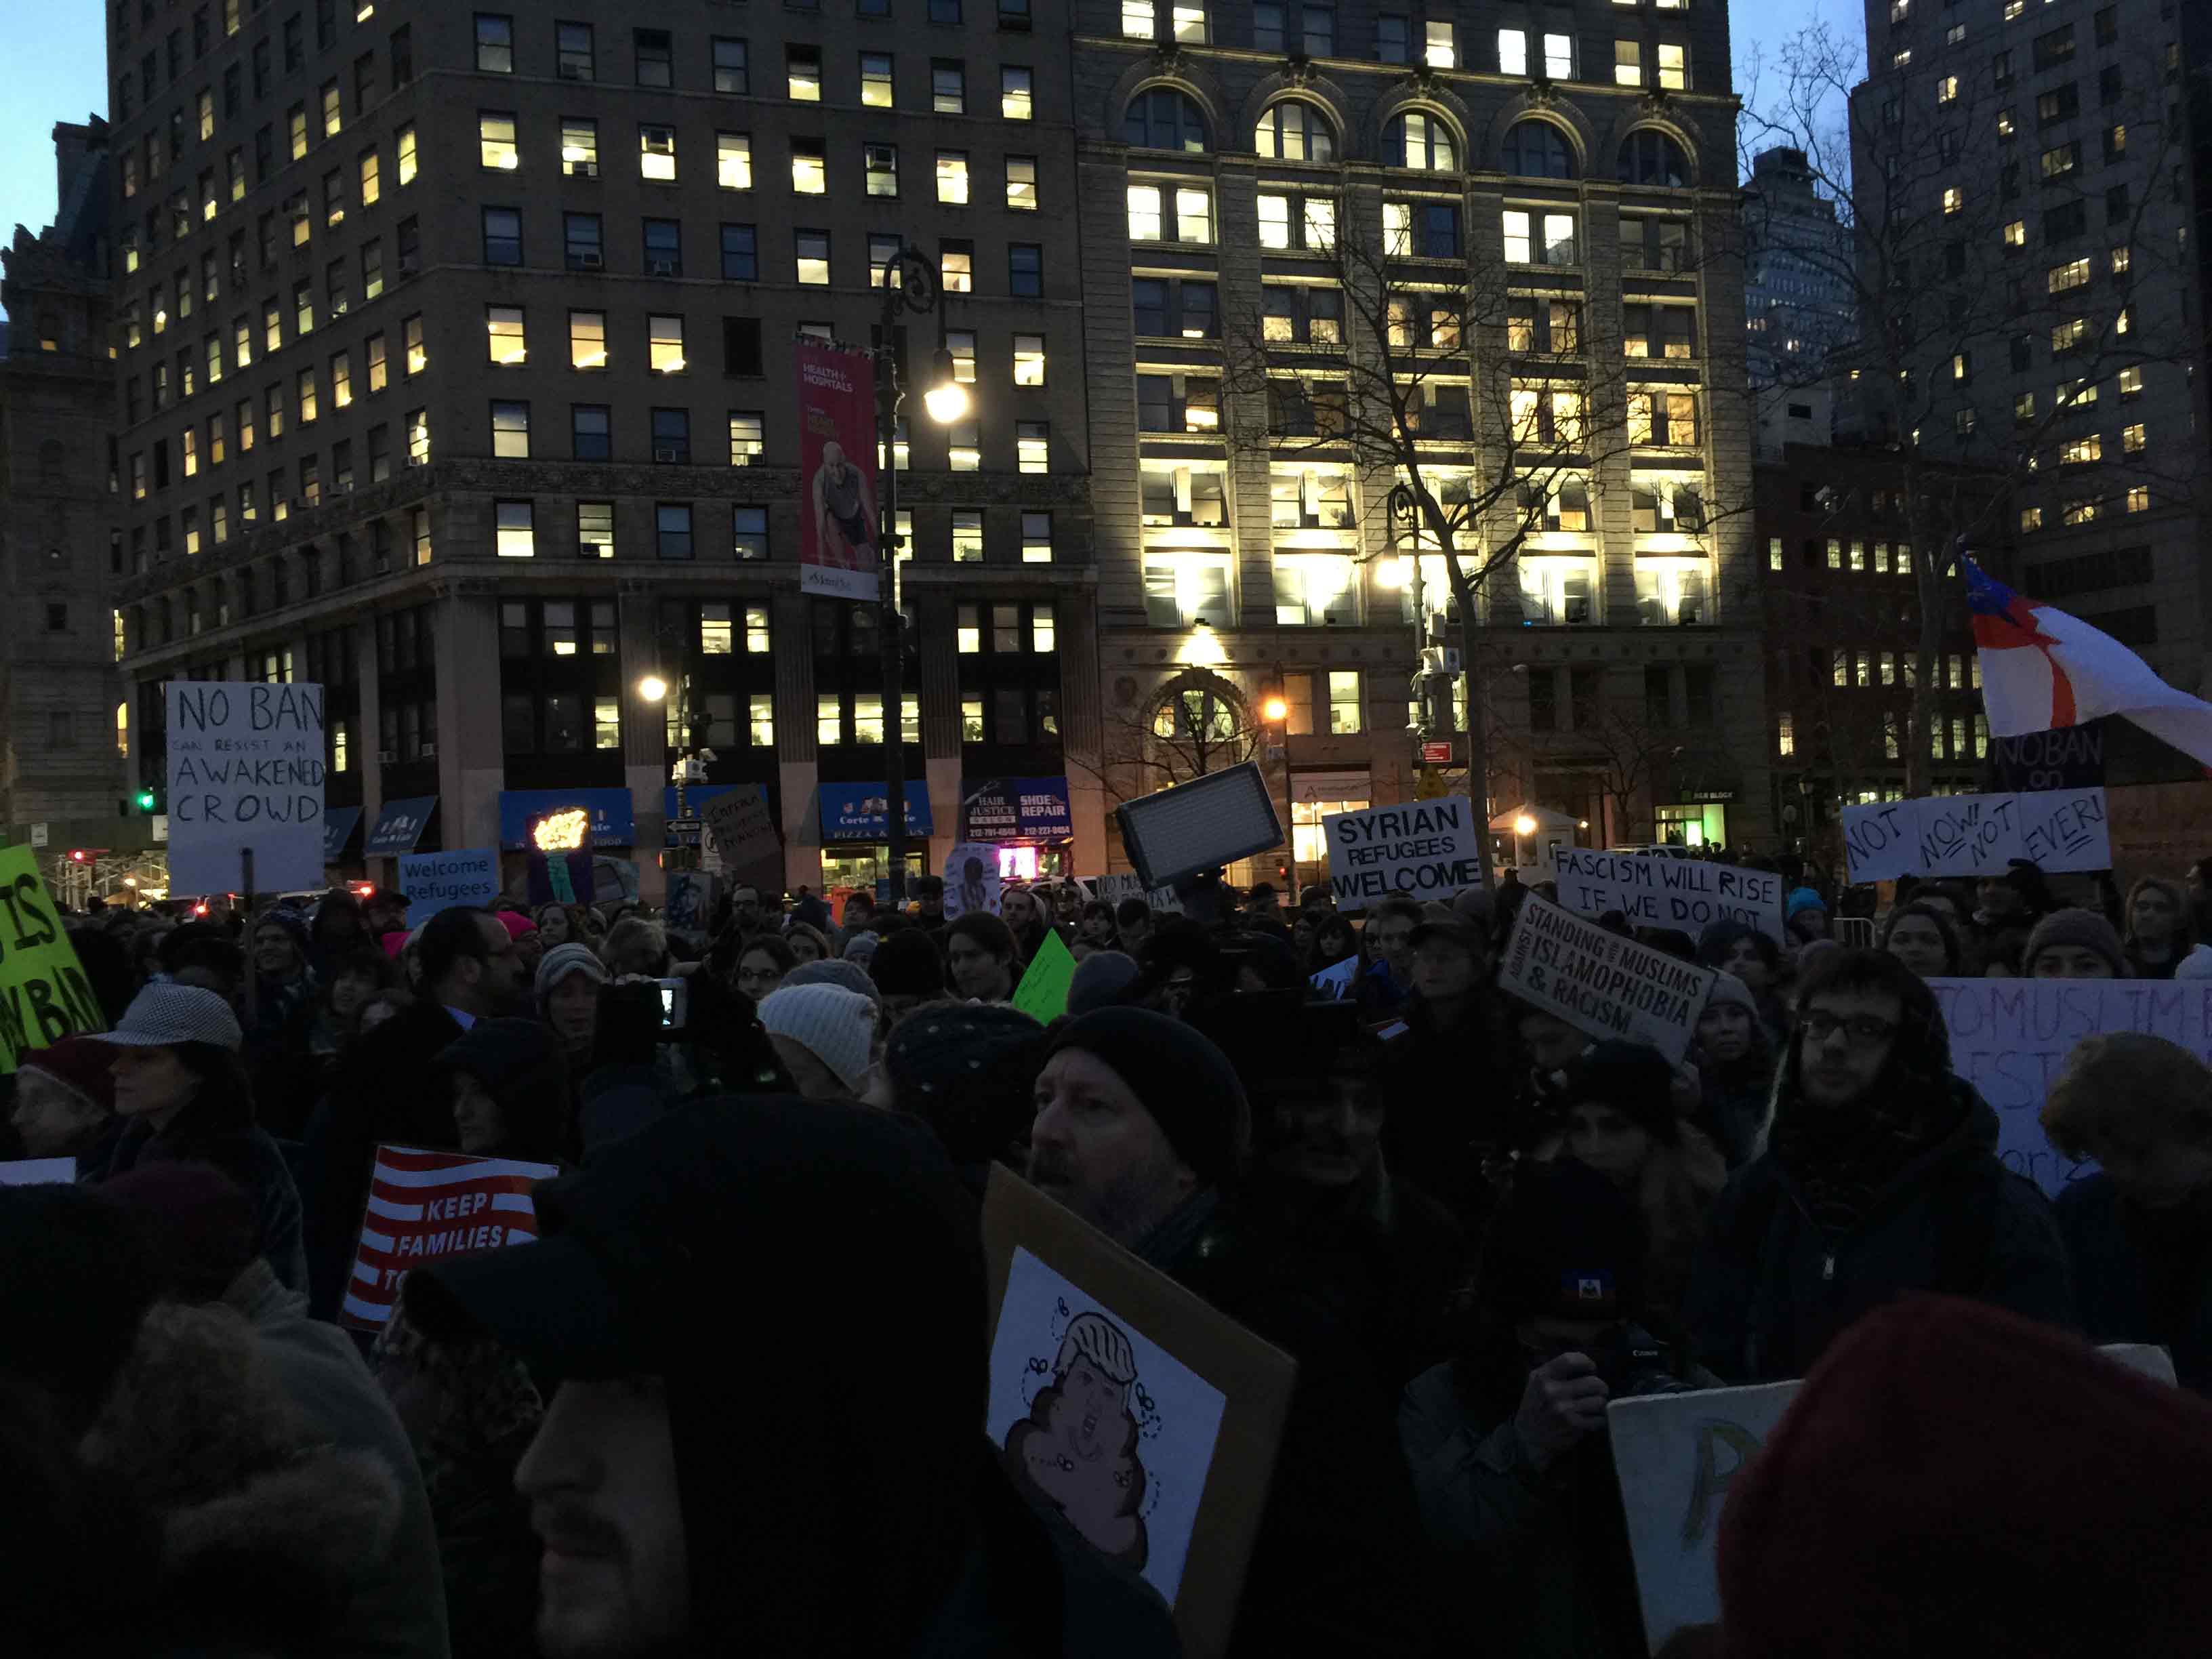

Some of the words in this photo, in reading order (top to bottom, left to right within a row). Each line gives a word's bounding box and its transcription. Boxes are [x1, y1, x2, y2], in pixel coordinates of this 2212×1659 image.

[802, 373, 855, 393] HOSPITALS
[179, 688, 228, 731] NO
[251, 686, 325, 731] BAN
[172, 739, 202, 751] CAN
[215, 739, 270, 752] RESIST
[283, 741, 306, 752] AN
[176, 757, 325, 786] AWAKENED
[178, 794, 319, 823] CROWD
[970, 806, 1015, 815] JUSTICE
[978, 796, 1005, 805] HAIR
[1020, 794, 1052, 805] SHOE
[1021, 806, 1066, 817] REPAIR
[1338, 804, 1459, 843] SYRIAN
[1846, 808, 1901, 871] NOT
[1969, 800, 2013, 867] NOT
[2025, 795, 2104, 863] EVER!
[1348, 836, 1456, 866] REFUGEES
[405, 860, 489, 878] Welcome
[1332, 859, 1481, 898] WELCOME
[1557, 851, 1652, 886] FASCISM
[1661, 865, 1712, 892] WILL
[1719, 872, 1774, 904] RISE
[407, 882, 490, 900] Refugees
[1578, 886, 1606, 911] IF
[1622, 895, 1658, 918] WE
[1671, 898, 1711, 923] DO
[1718, 903, 1760, 933] NOT
[1510, 928, 1532, 980] AGAINST
[1526, 903, 1605, 958] STANDING
[1619, 947, 1702, 997] MUSLIMS
[1532, 936, 1690, 1027] ISLAMOPHOBIA
[1528, 966, 1546, 993] &
[1553, 978, 1633, 1034] RACISM
[427, 1192, 488, 1222] KEEP
[397, 1225, 503, 1257] FAMILIES
